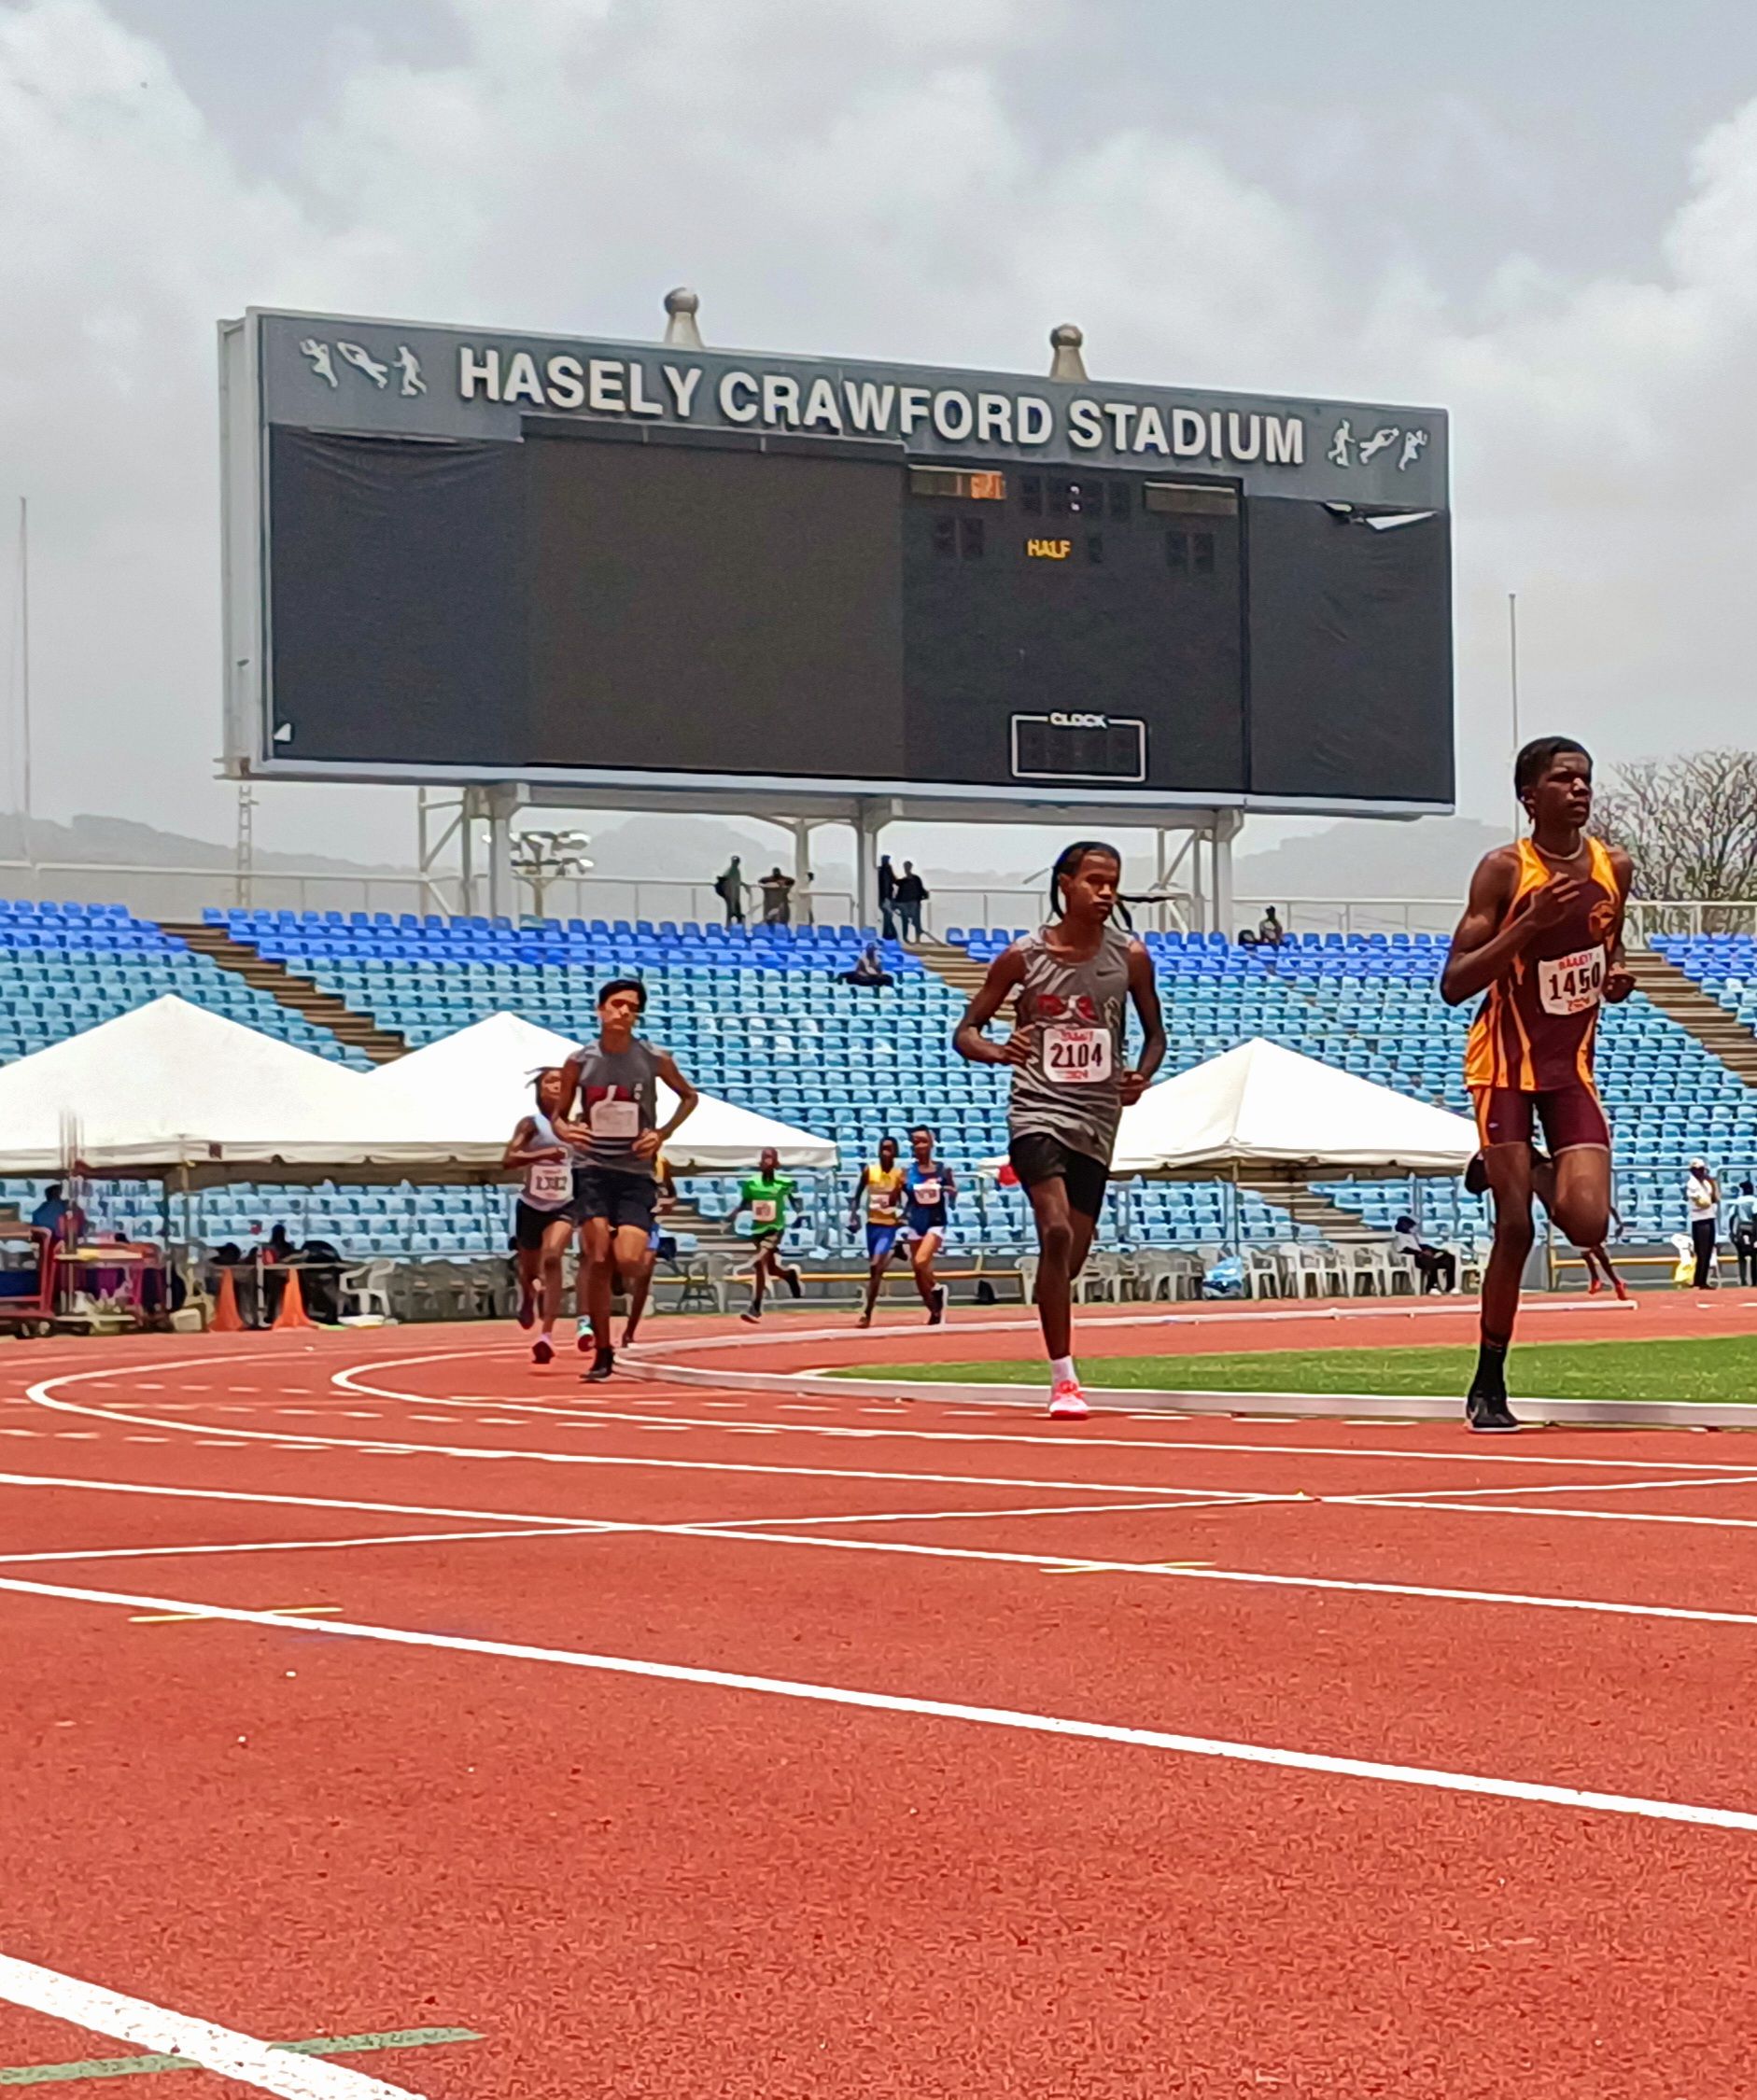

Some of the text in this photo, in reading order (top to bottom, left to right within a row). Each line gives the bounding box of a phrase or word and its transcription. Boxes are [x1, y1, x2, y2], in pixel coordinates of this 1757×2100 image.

[458, 346, 1304, 465] HASELY CRAWFORD STADIUM
[1027, 539, 1071, 559] HALF
[1049, 711, 1107, 728] CLOCK
[1549, 961, 1601, 1001] 1450
[1049, 1043, 1103, 1068] 2104
